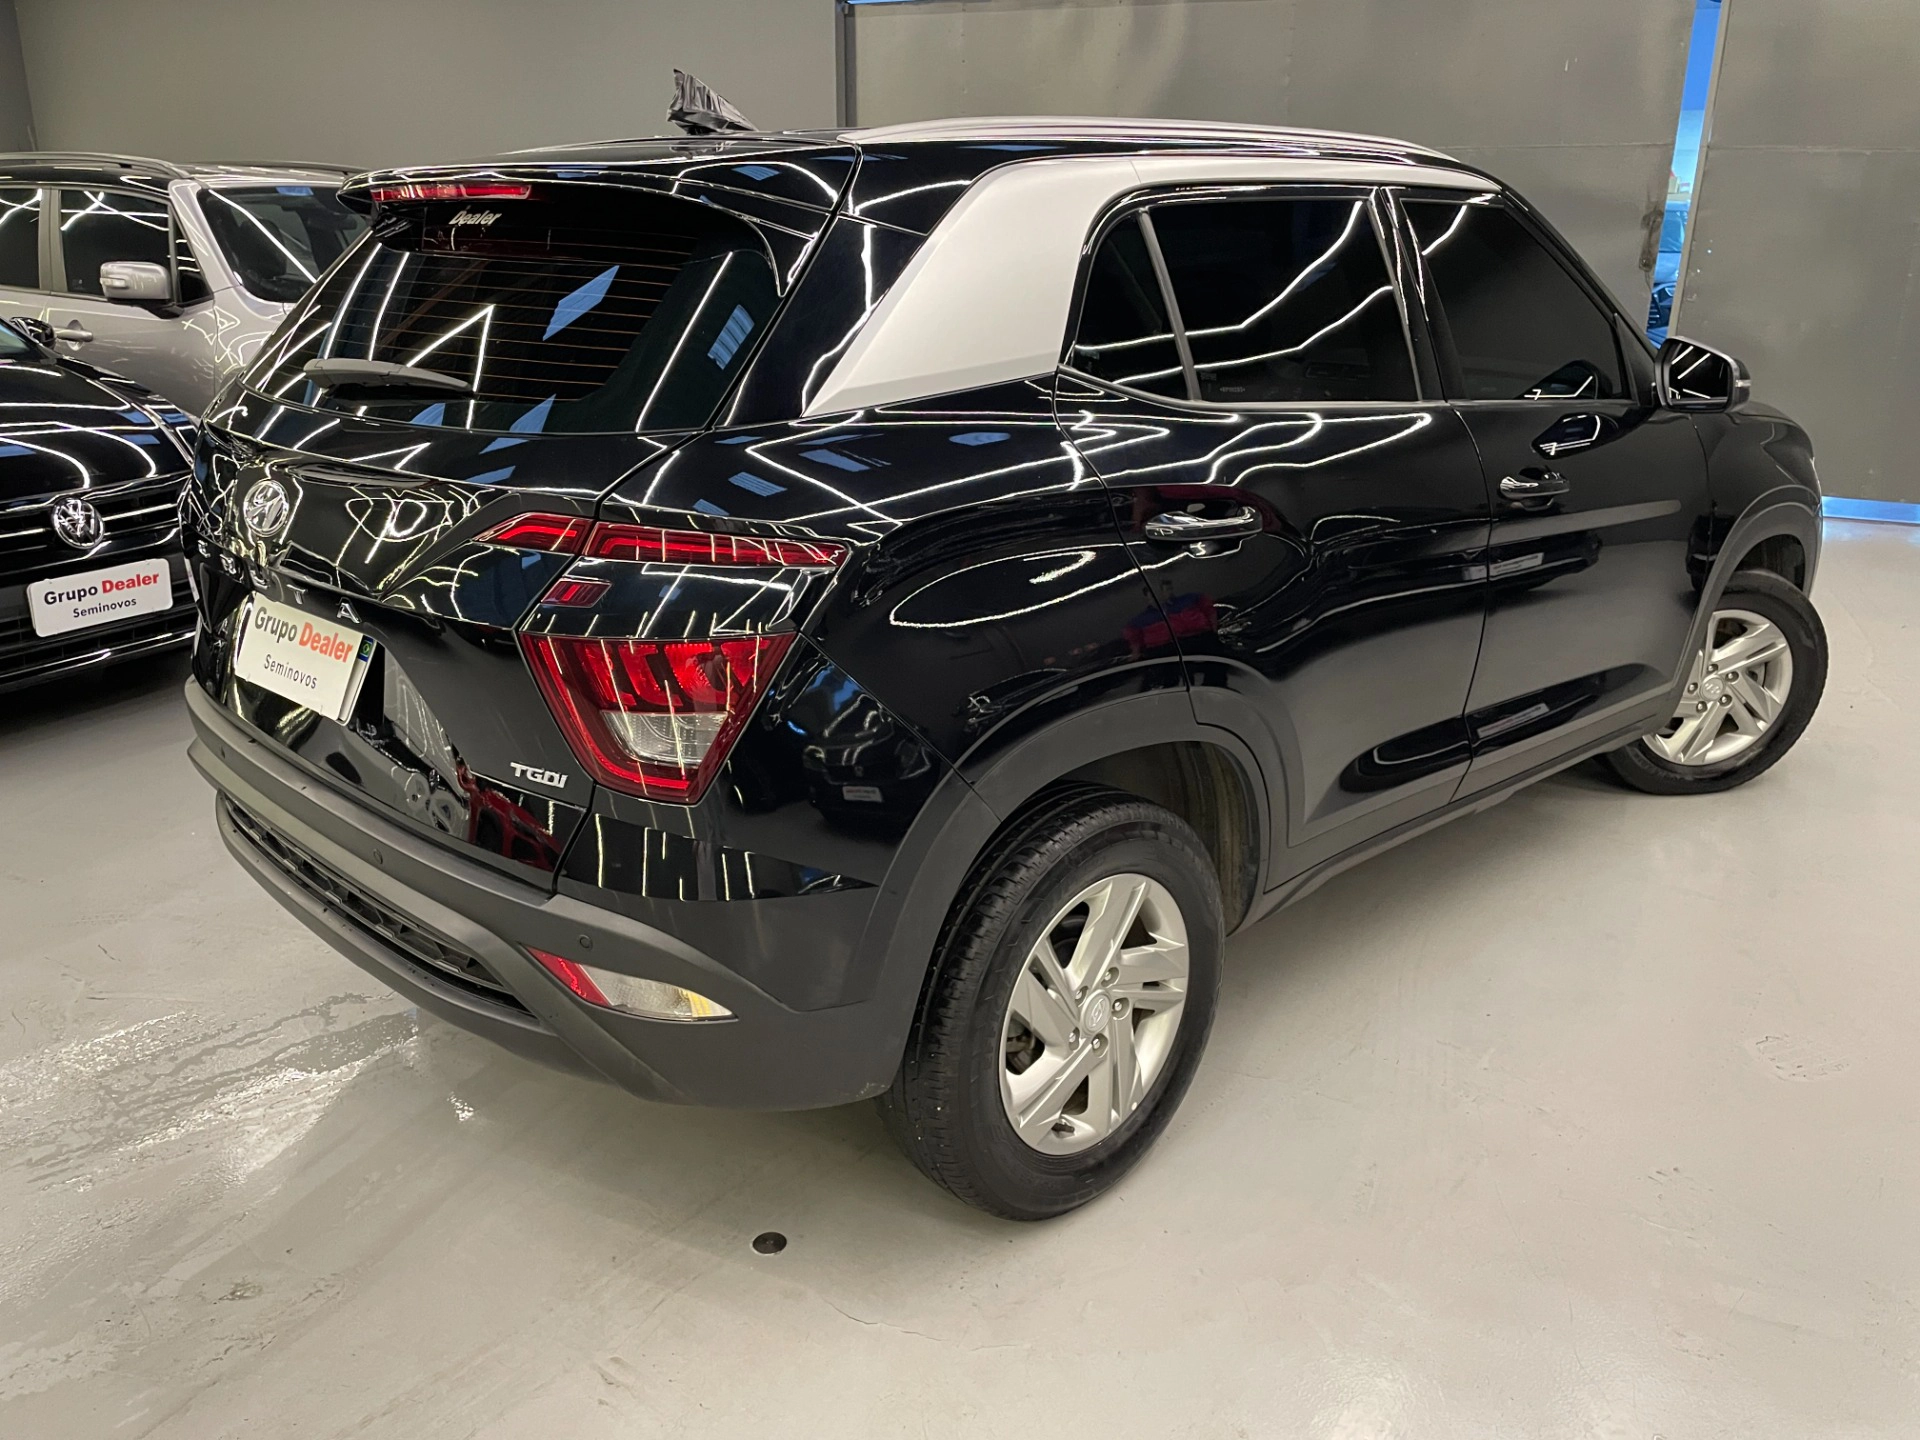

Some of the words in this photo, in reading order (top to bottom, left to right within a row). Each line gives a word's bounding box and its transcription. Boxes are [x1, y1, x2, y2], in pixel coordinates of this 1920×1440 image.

[448, 207, 502, 226] Dealer
[44, 585, 98, 605] Grupo
[102, 573, 159, 594] Dealer
[73, 598, 137, 618] Seminovos
[254, 606, 298, 643] Grupo
[299, 621, 353, 663] Dealer
[264, 653, 317, 689] Seminovos
[510, 761, 568, 788] TGDI
